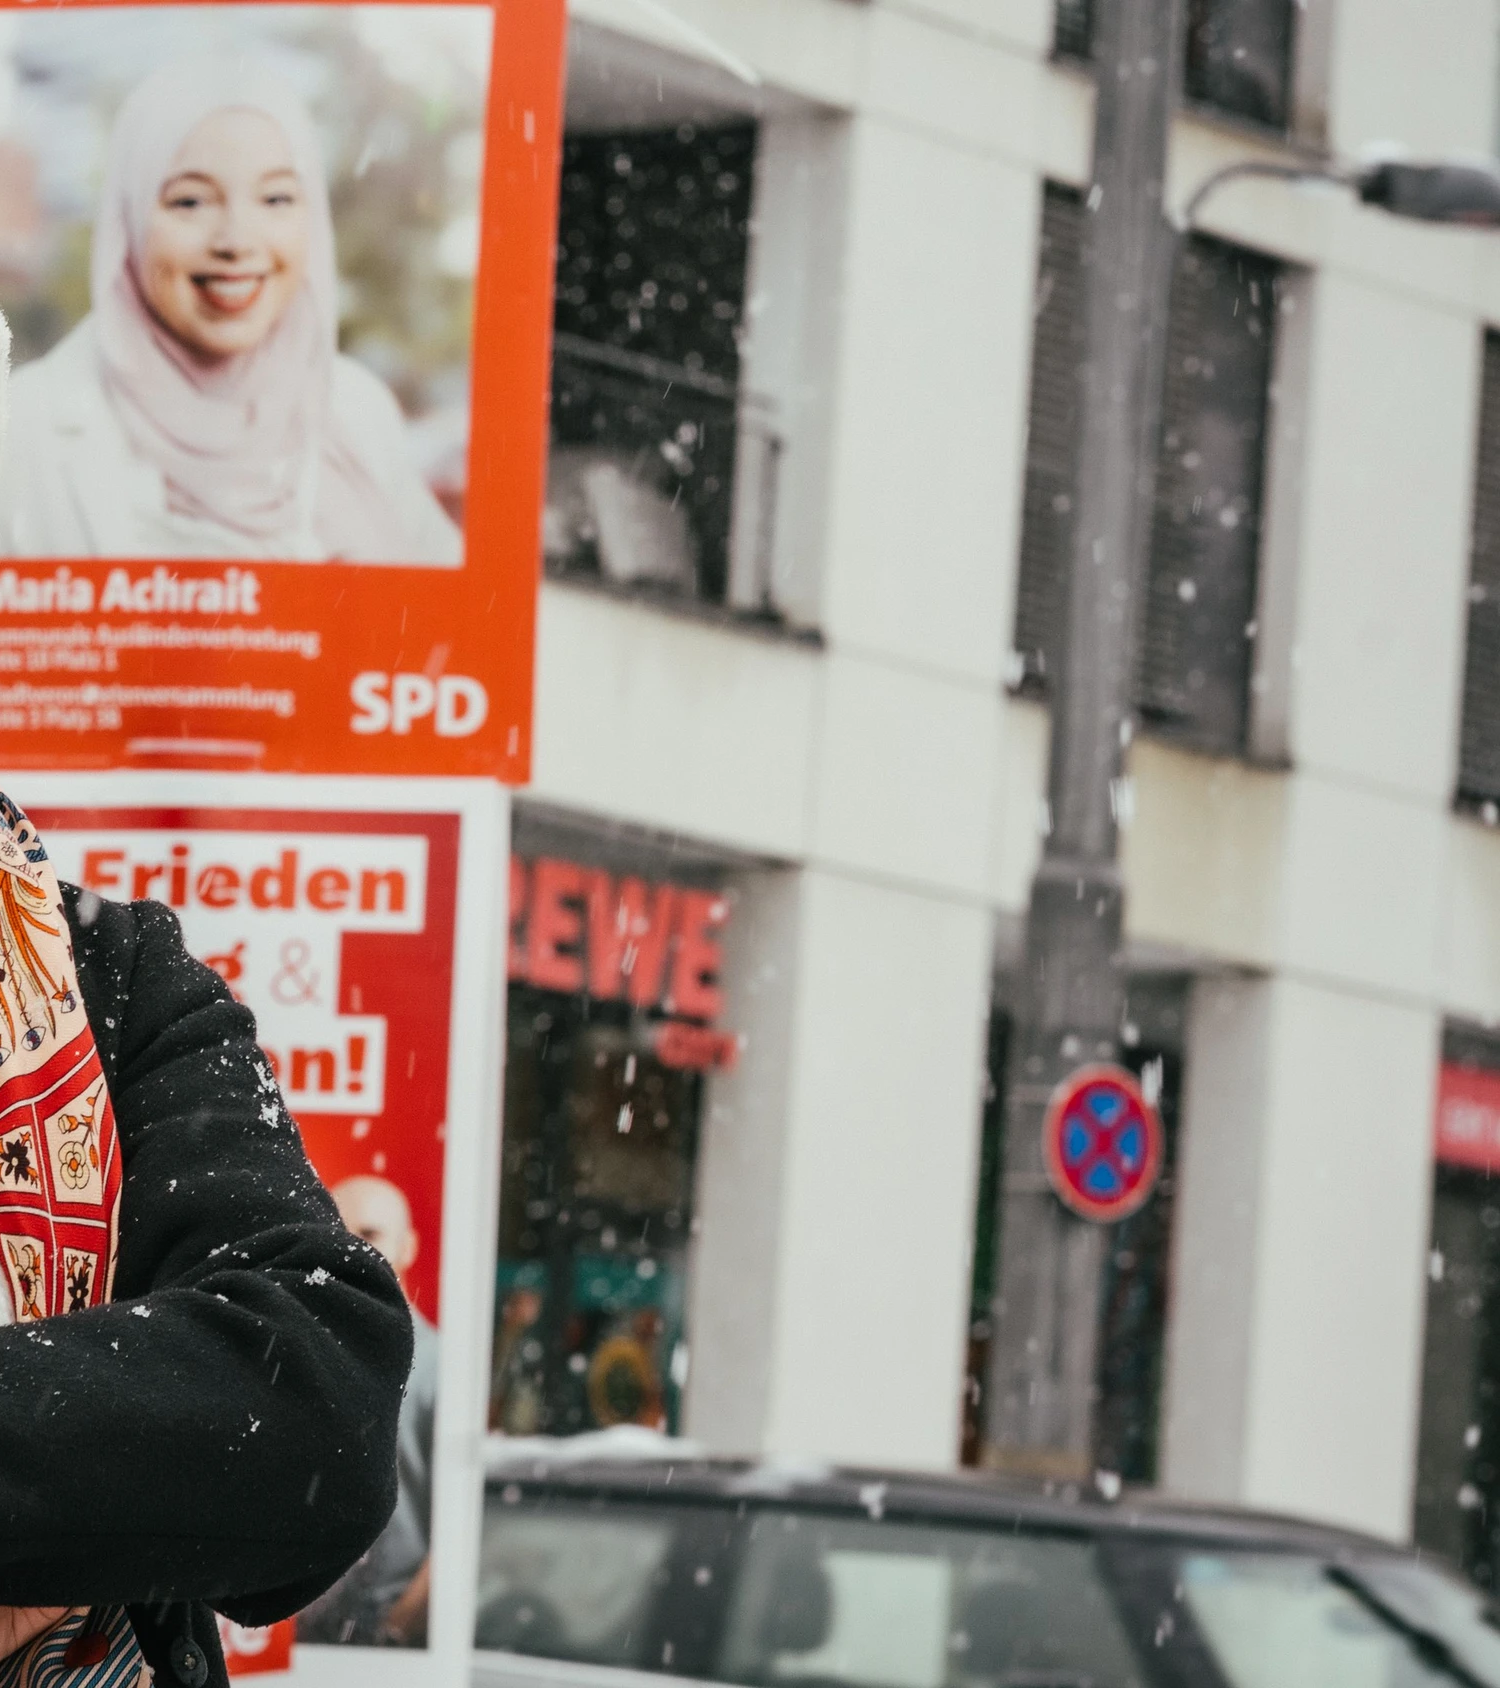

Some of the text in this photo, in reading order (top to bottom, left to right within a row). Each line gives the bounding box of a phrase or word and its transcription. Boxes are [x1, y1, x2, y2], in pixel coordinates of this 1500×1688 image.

[100, 565, 261, 615] Achrait
[350, 671, 488, 737] SPD
[82, 845, 407, 912] Frieden
[270, 939, 324, 1007] &
